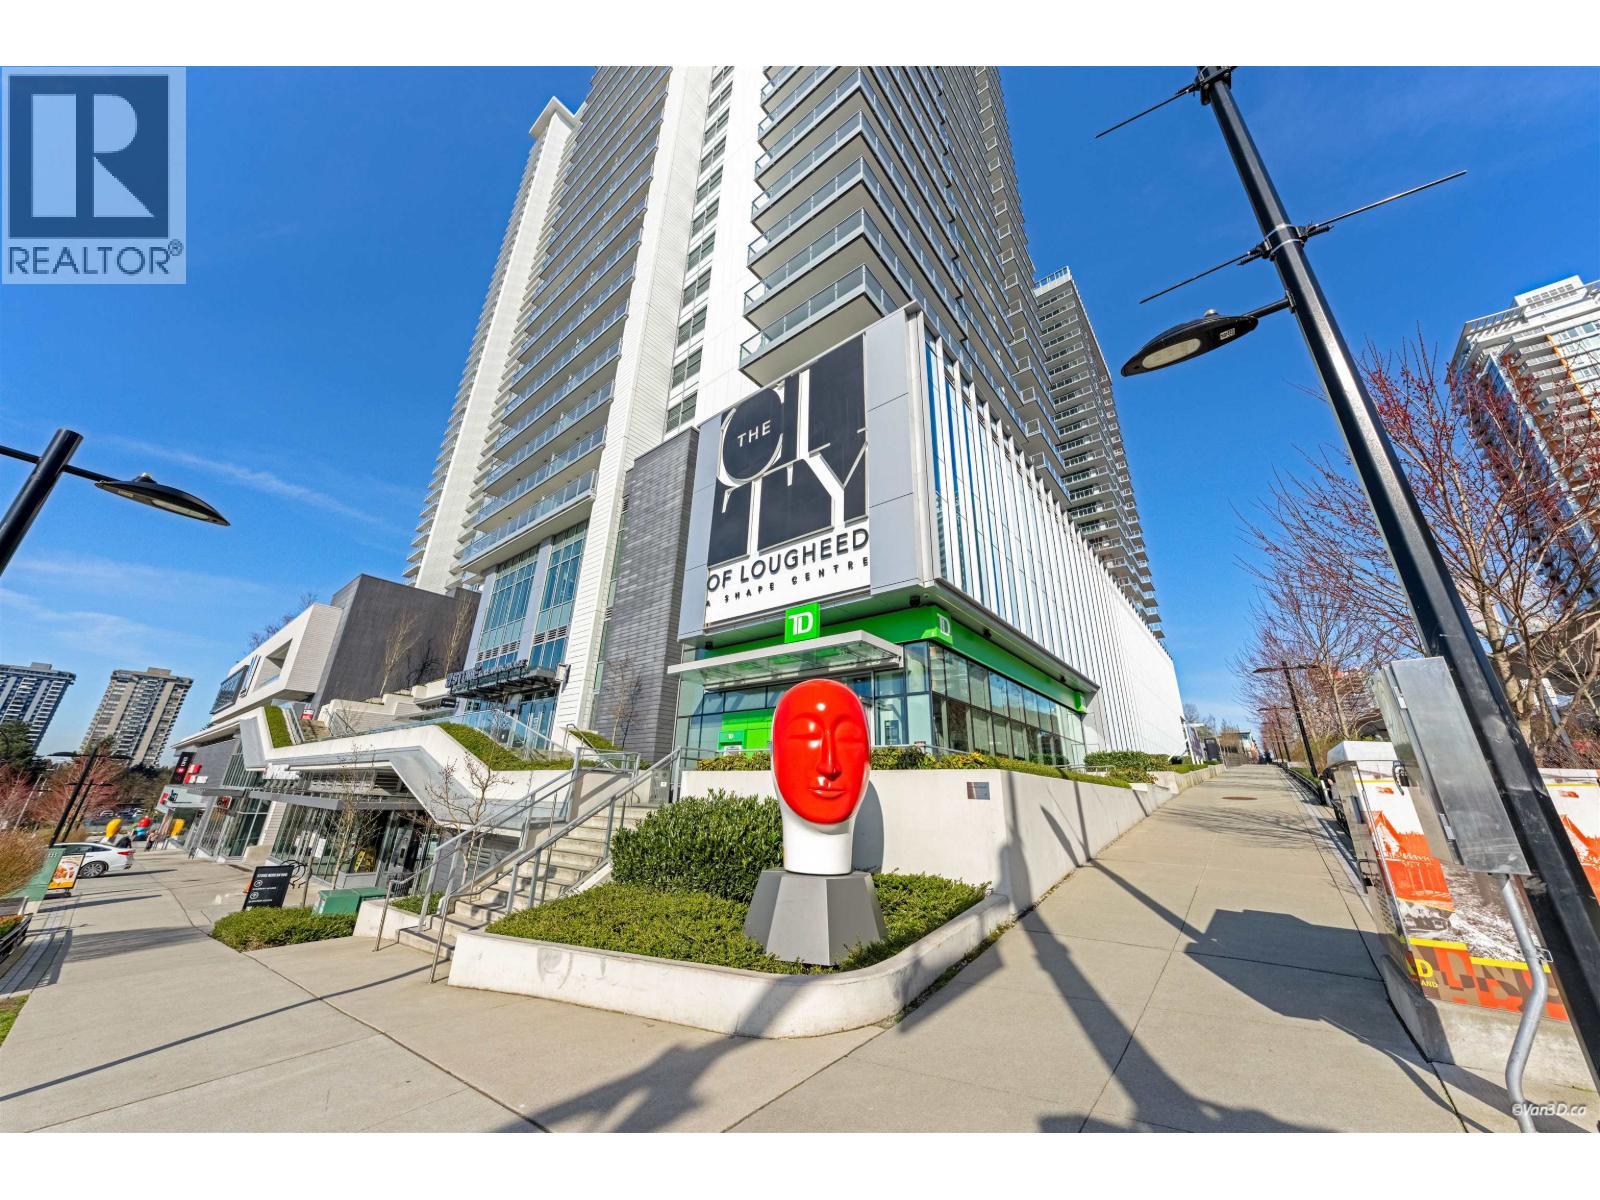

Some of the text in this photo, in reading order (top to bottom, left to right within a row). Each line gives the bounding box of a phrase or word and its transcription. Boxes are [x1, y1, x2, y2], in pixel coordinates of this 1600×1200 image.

[737, 419, 771, 447] THE
[707, 528, 869, 592] OF LOUGHEED
[724, 582, 775, 602] SHAPE
[791, 556, 868, 585] CENTRE
[788, 611, 814, 636] TD
